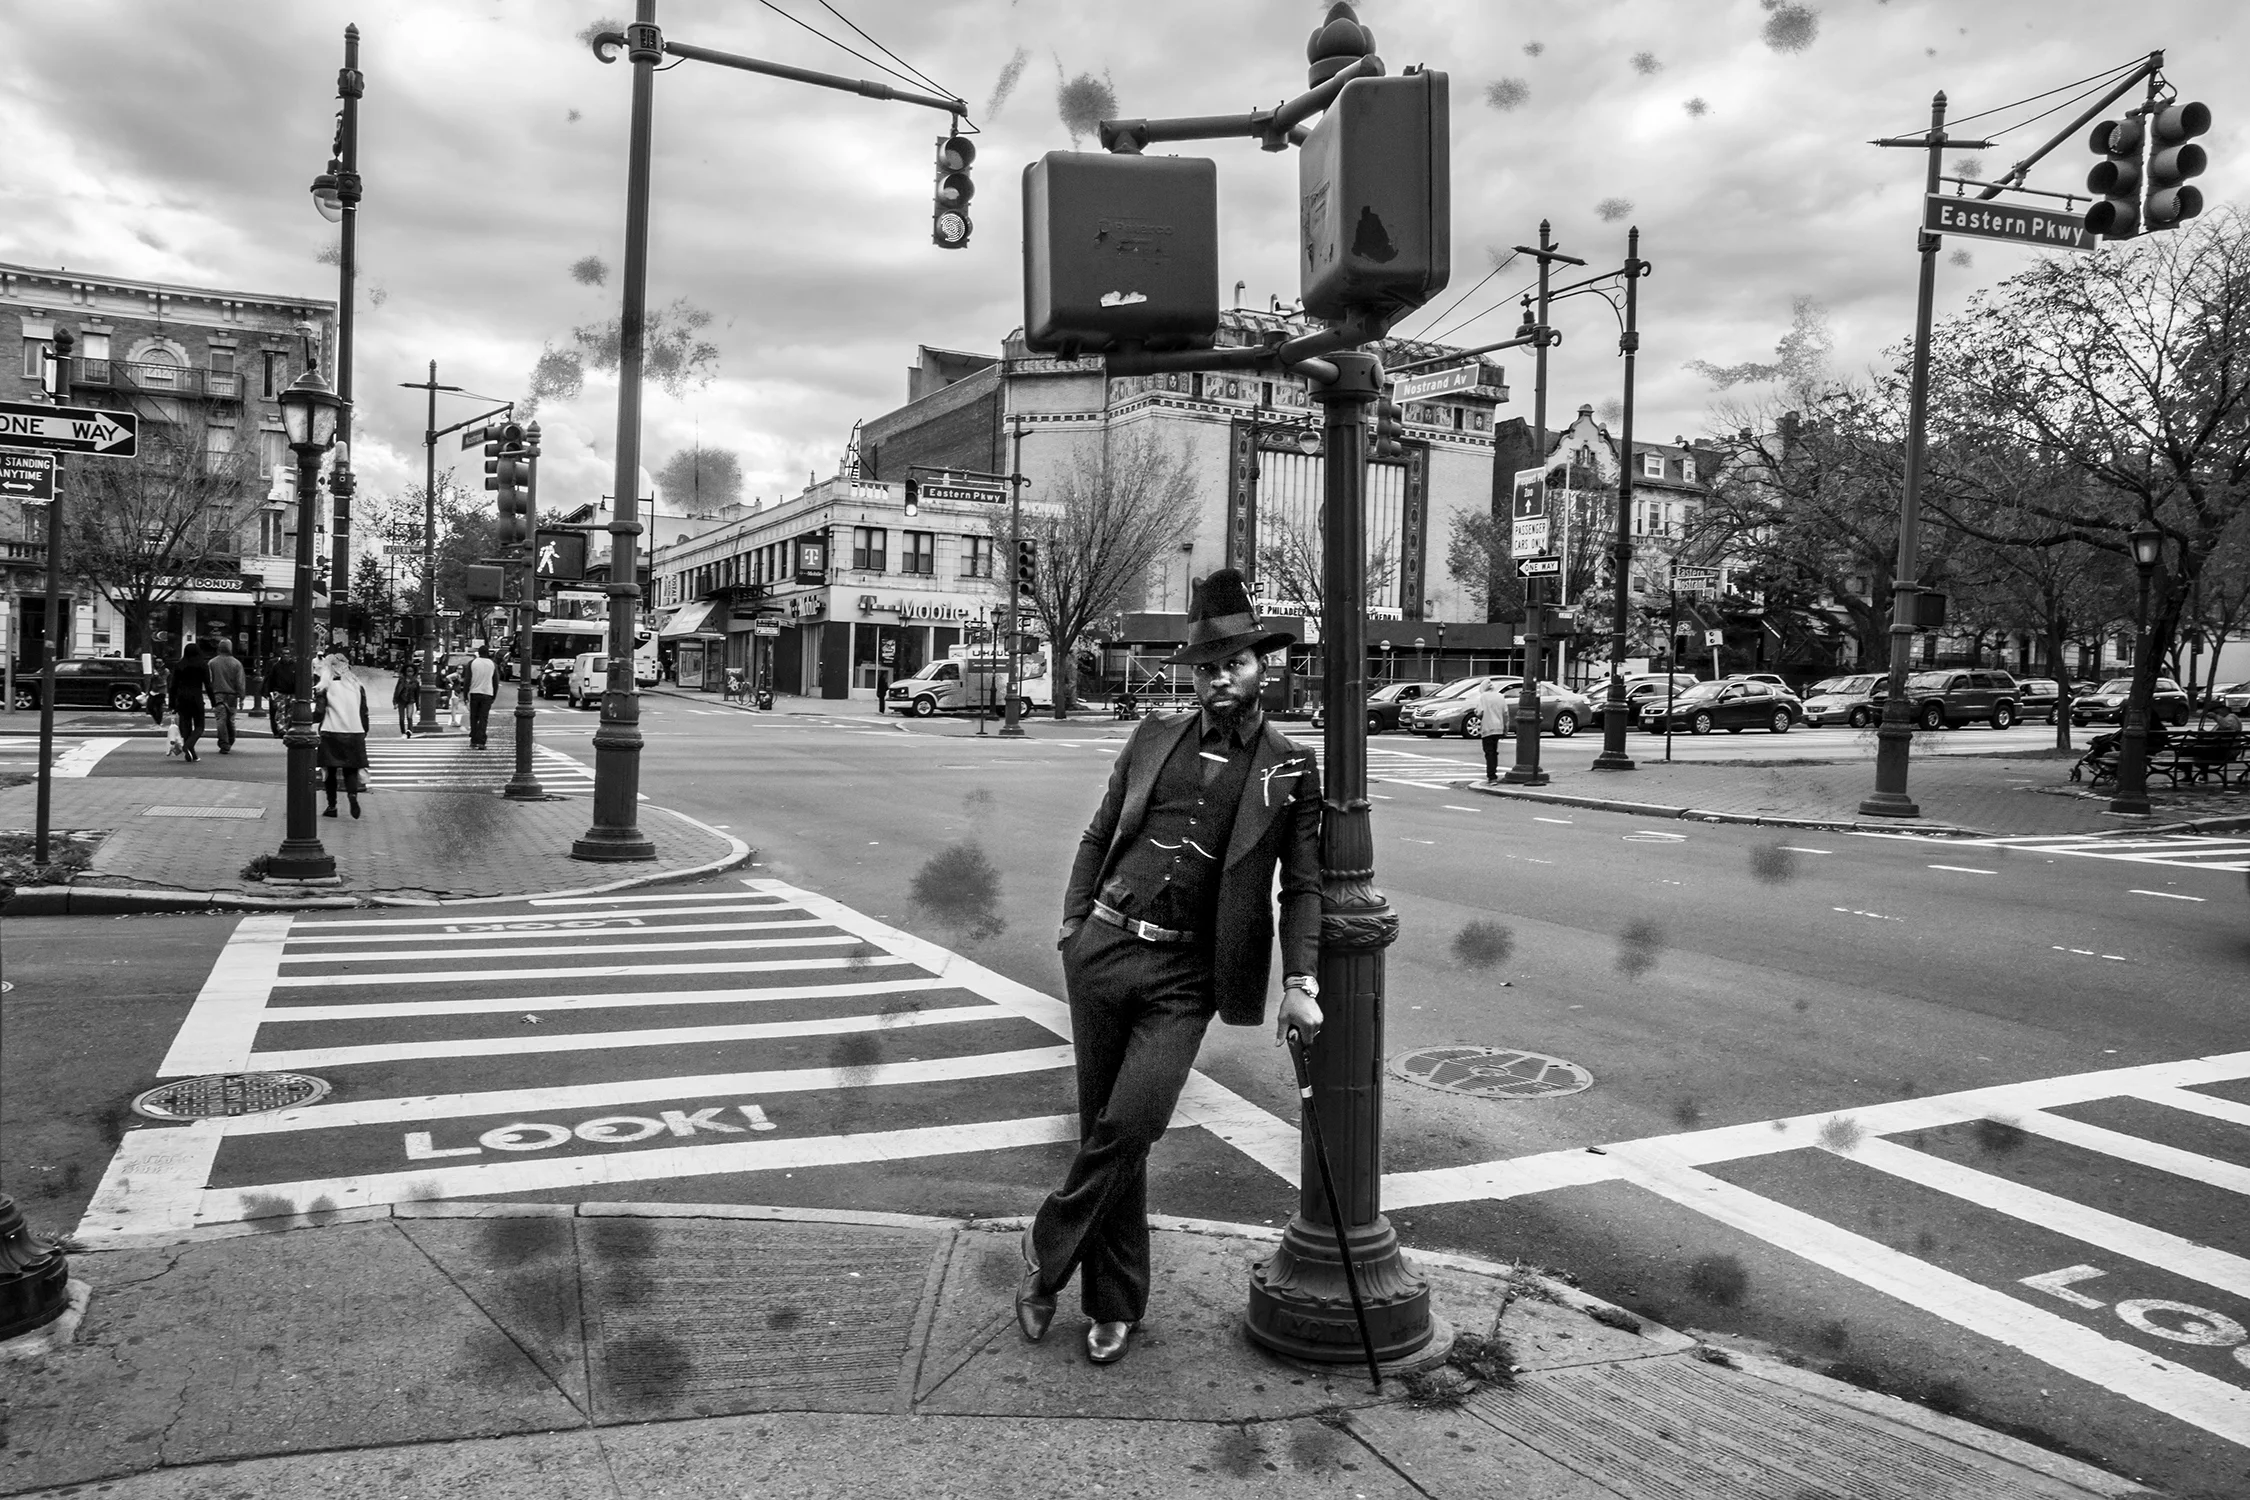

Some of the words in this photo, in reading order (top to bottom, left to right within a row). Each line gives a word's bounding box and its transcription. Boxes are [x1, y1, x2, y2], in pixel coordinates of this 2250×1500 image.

[1940, 205, 2026, 234] Eastern
[2031, 217, 2084, 246] Pkwy
[1403, 376, 1450, 396] Nostrand
[1453, 373, 1468, 386] Av
[0, 415, 44, 435] ONE
[72, 422, 119, 441] WAY
[5, 457, 50, 470] STANDING
[929, 488, 971, 499] Eastern
[973, 491, 1001, 503] Pkwy
[1524, 487, 1534, 498] Zoo
[1515, 522, 1546, 536] PASSENGER
[1515, 538, 1529, 551] CARS
[1531, 537, 1545, 549] ONLY
[1524, 563, 1538, 572] ONE
[1541, 562, 1555, 571] WAY
[1677, 567, 1705, 577] Eastern
[195, 579, 244, 589] DONUTS
[1675, 577, 1707, 589] Nostrand
[443, 917, 646, 933] LOOK!
[404, 1104, 777, 1160] LOOK!
[2016, 1263, 2250, 1370] LO
